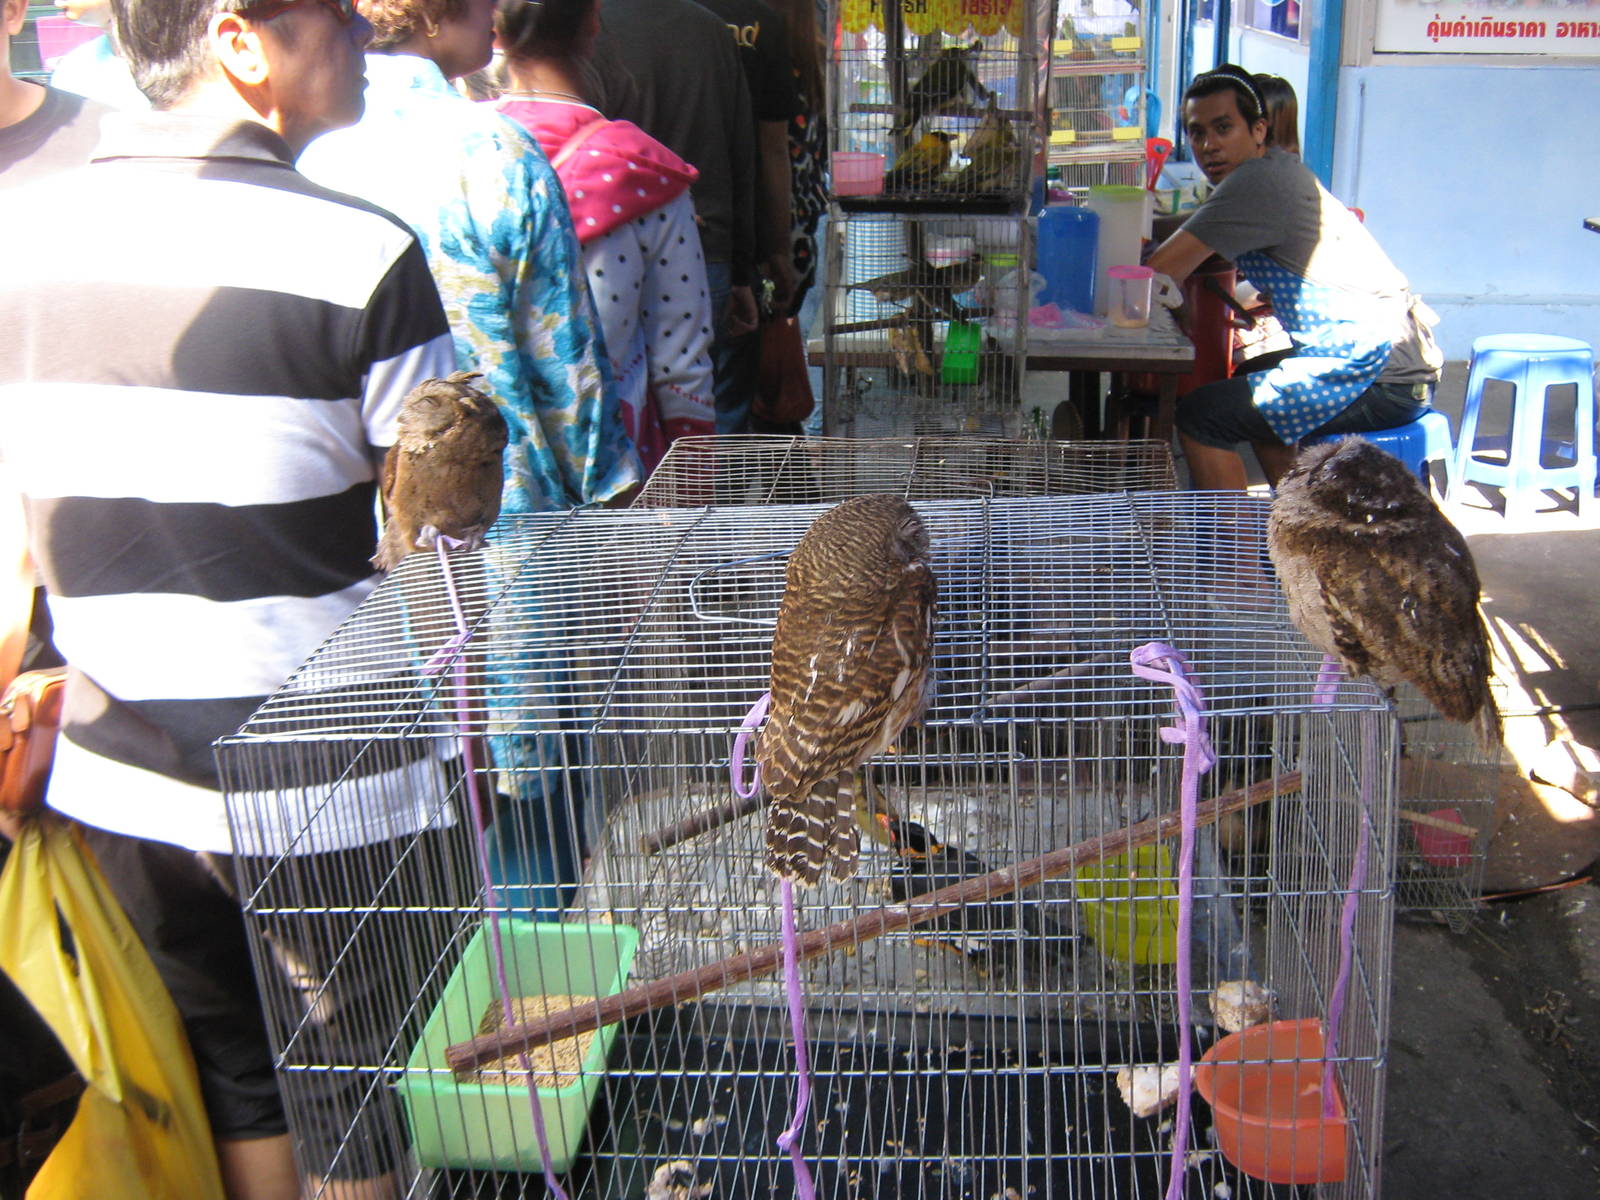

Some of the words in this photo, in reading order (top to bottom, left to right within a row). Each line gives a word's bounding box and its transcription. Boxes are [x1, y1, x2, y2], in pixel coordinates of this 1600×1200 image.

[1427, 13, 1546, 42] คุ้มค่าเกินราคา
[1555, 21, 1600, 38] อาหา
